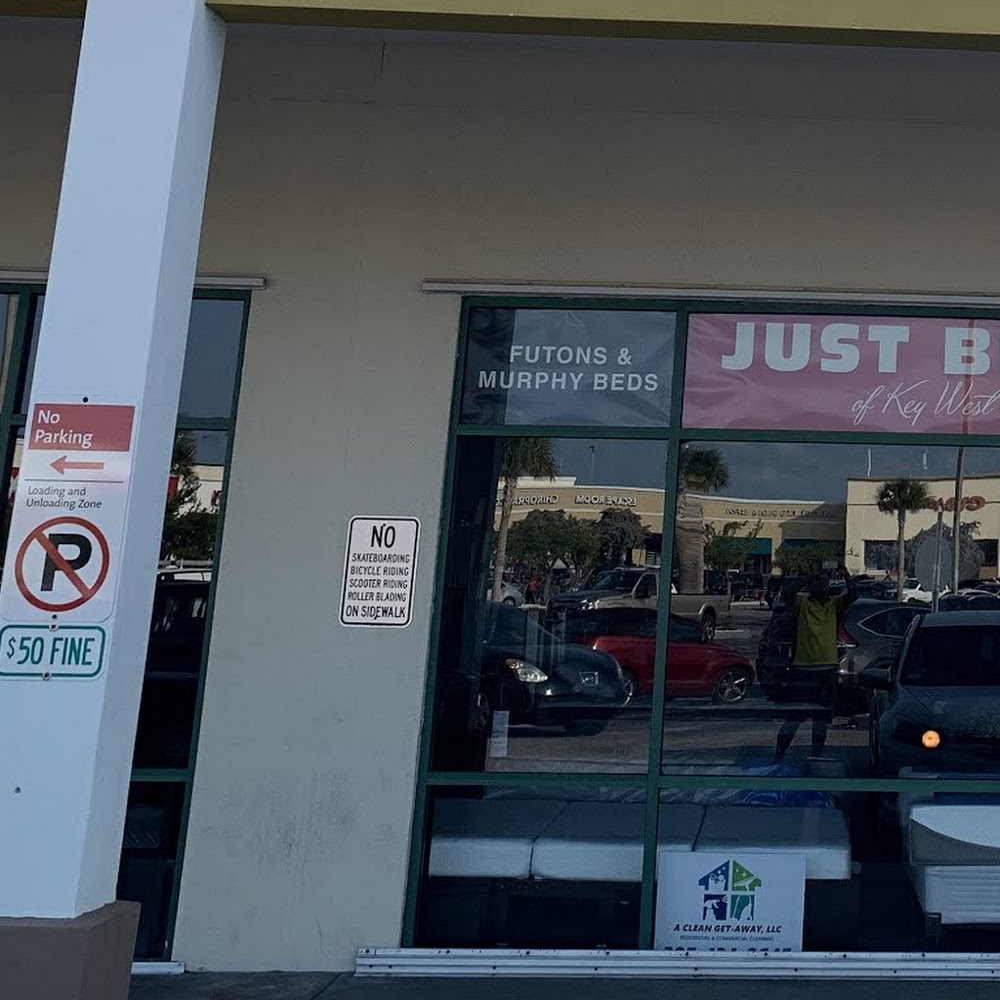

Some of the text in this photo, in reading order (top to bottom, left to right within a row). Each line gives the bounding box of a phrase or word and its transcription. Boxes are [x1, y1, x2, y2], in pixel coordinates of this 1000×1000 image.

[721, 322, 910, 373] JUST
[509, 345, 632, 365] FUTONS &
[478, 371, 659, 392] MURPHY BEDS
[852, 384, 883, 426] of
[882, 379, 929, 426] Key
[38, 409, 60, 425] No
[35, 429, 93, 448] Parking
[28, 486, 86, 498] Loading and
[26, 498, 102, 511] Unloading Zone
[370, 525, 396, 548] NO
[352, 553, 410, 563] SKATEBOARDING
[350, 566, 409, 576] BICYCLE RIDING
[349, 578, 408, 589] SCOOTER RIDING
[347, 591, 406, 602] ROLLER BLADING
[345, 605, 406, 618] ON SIDEWALK
[6, 636, 95, 666] $50 FINE
[673, 924, 782, 934] A CLEAN GET-AWAY, LLC
